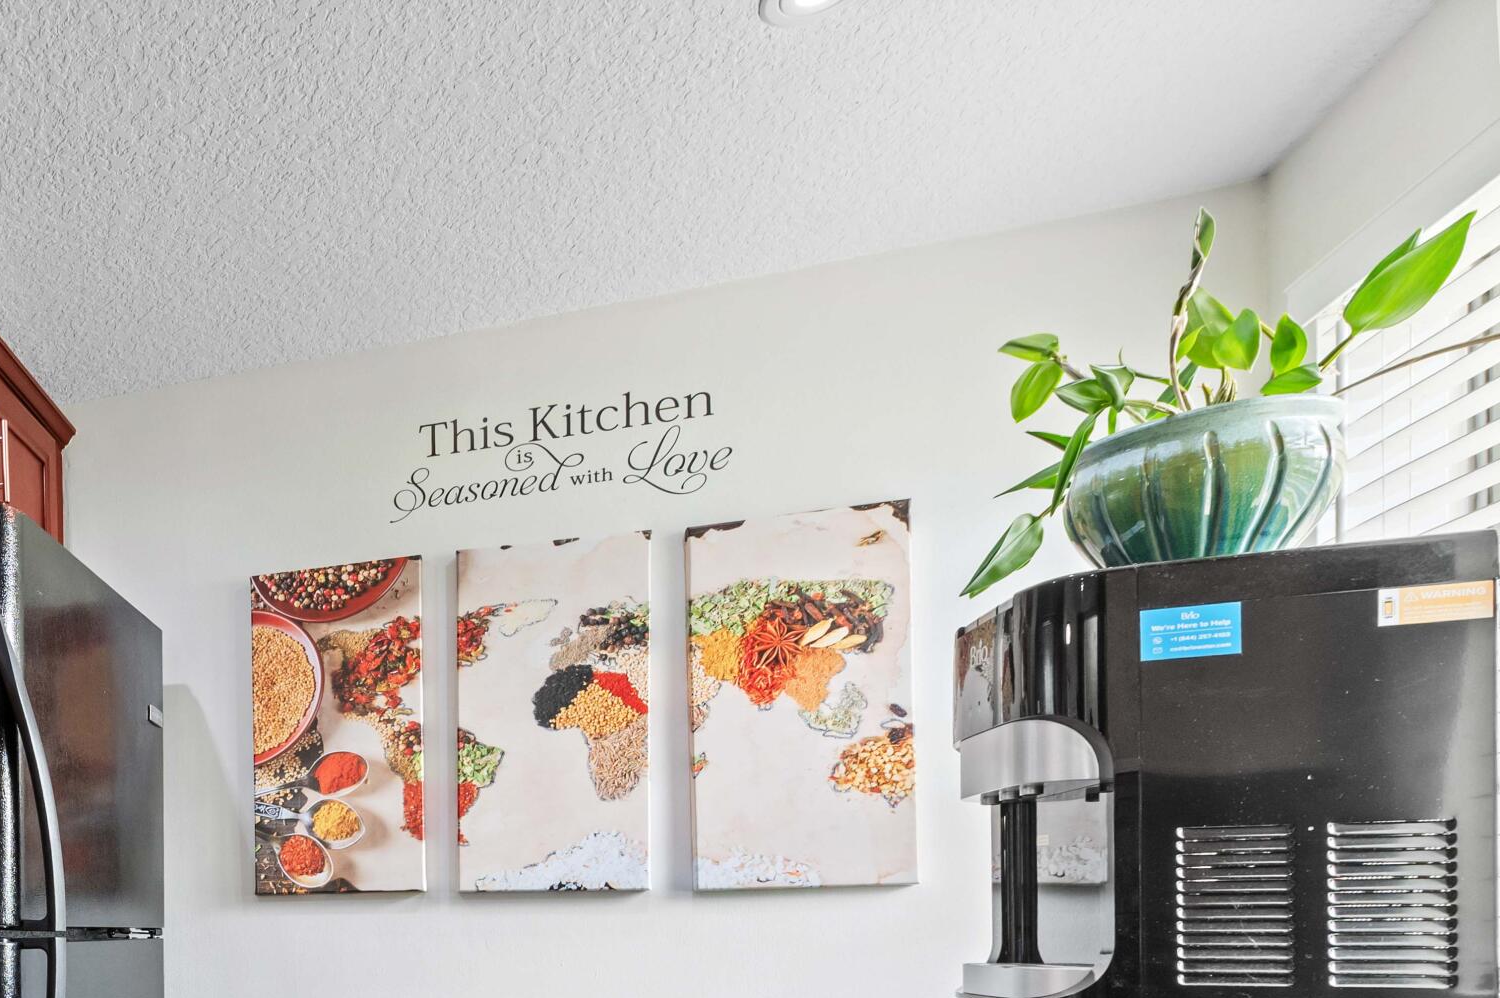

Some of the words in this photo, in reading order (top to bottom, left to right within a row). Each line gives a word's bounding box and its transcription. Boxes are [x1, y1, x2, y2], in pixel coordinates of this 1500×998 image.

[418, 417, 515, 458] This
[529, 390, 715, 442] Kitchen
[516, 449, 535, 465] is
[389, 443, 585, 523] Seasoned
[570, 468, 613, 486] with
[623, 425, 733, 495] Love
[1421, 586, 1487, 600] WARNING
[1181, 611, 1200, 620] Brio
[1151, 624, 1175, 632] We're
[1177, 621, 1198, 630] Here
[1210, 618, 1232, 627] Help
